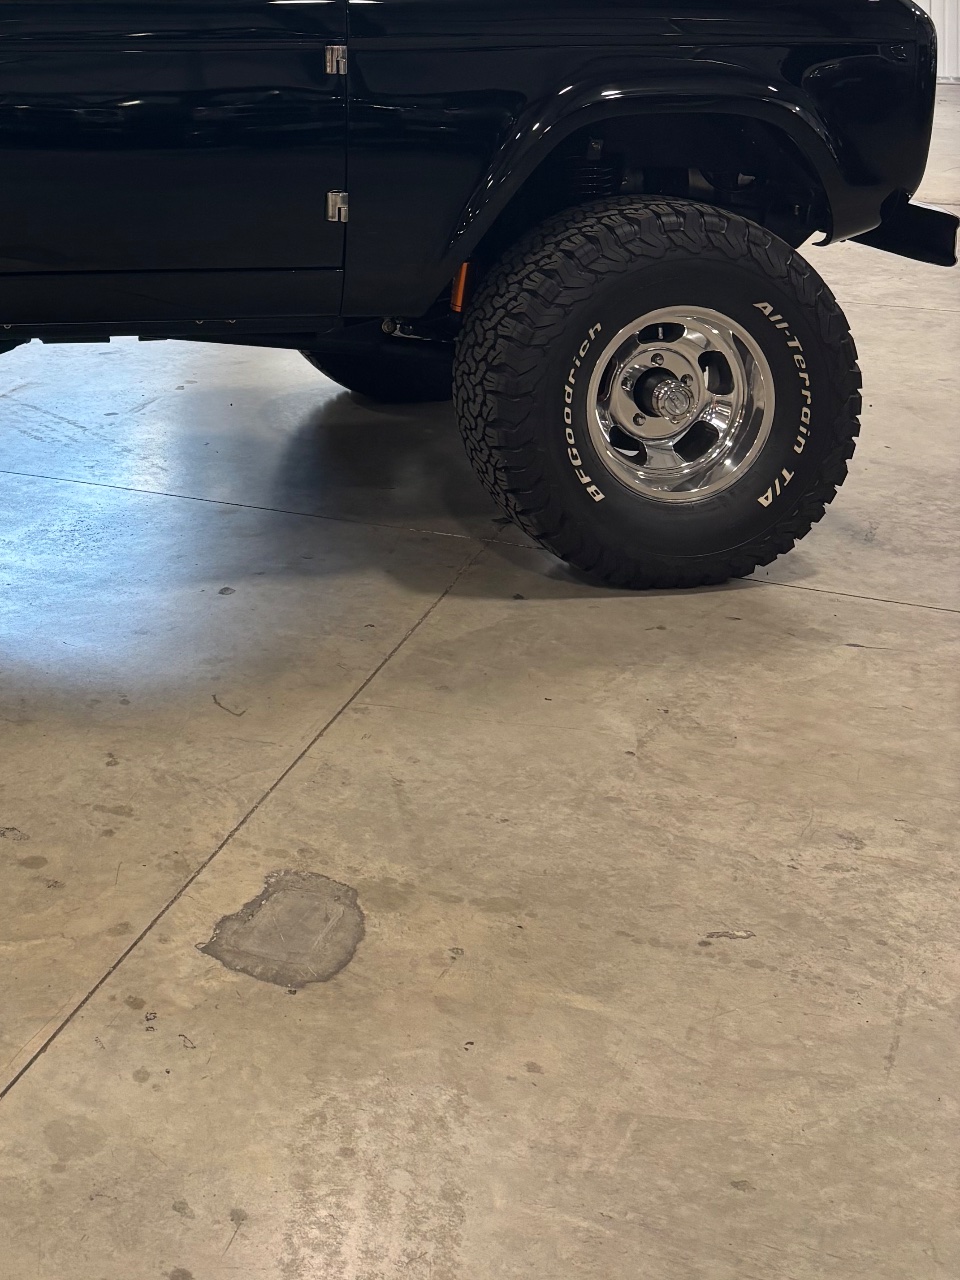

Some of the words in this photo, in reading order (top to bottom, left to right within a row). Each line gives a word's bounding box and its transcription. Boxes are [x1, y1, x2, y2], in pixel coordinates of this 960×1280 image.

[565, 323, 605, 501] BFGoodrich
[754, 303, 811, 453] All-Terrain
[758, 469, 794, 507] T/A
